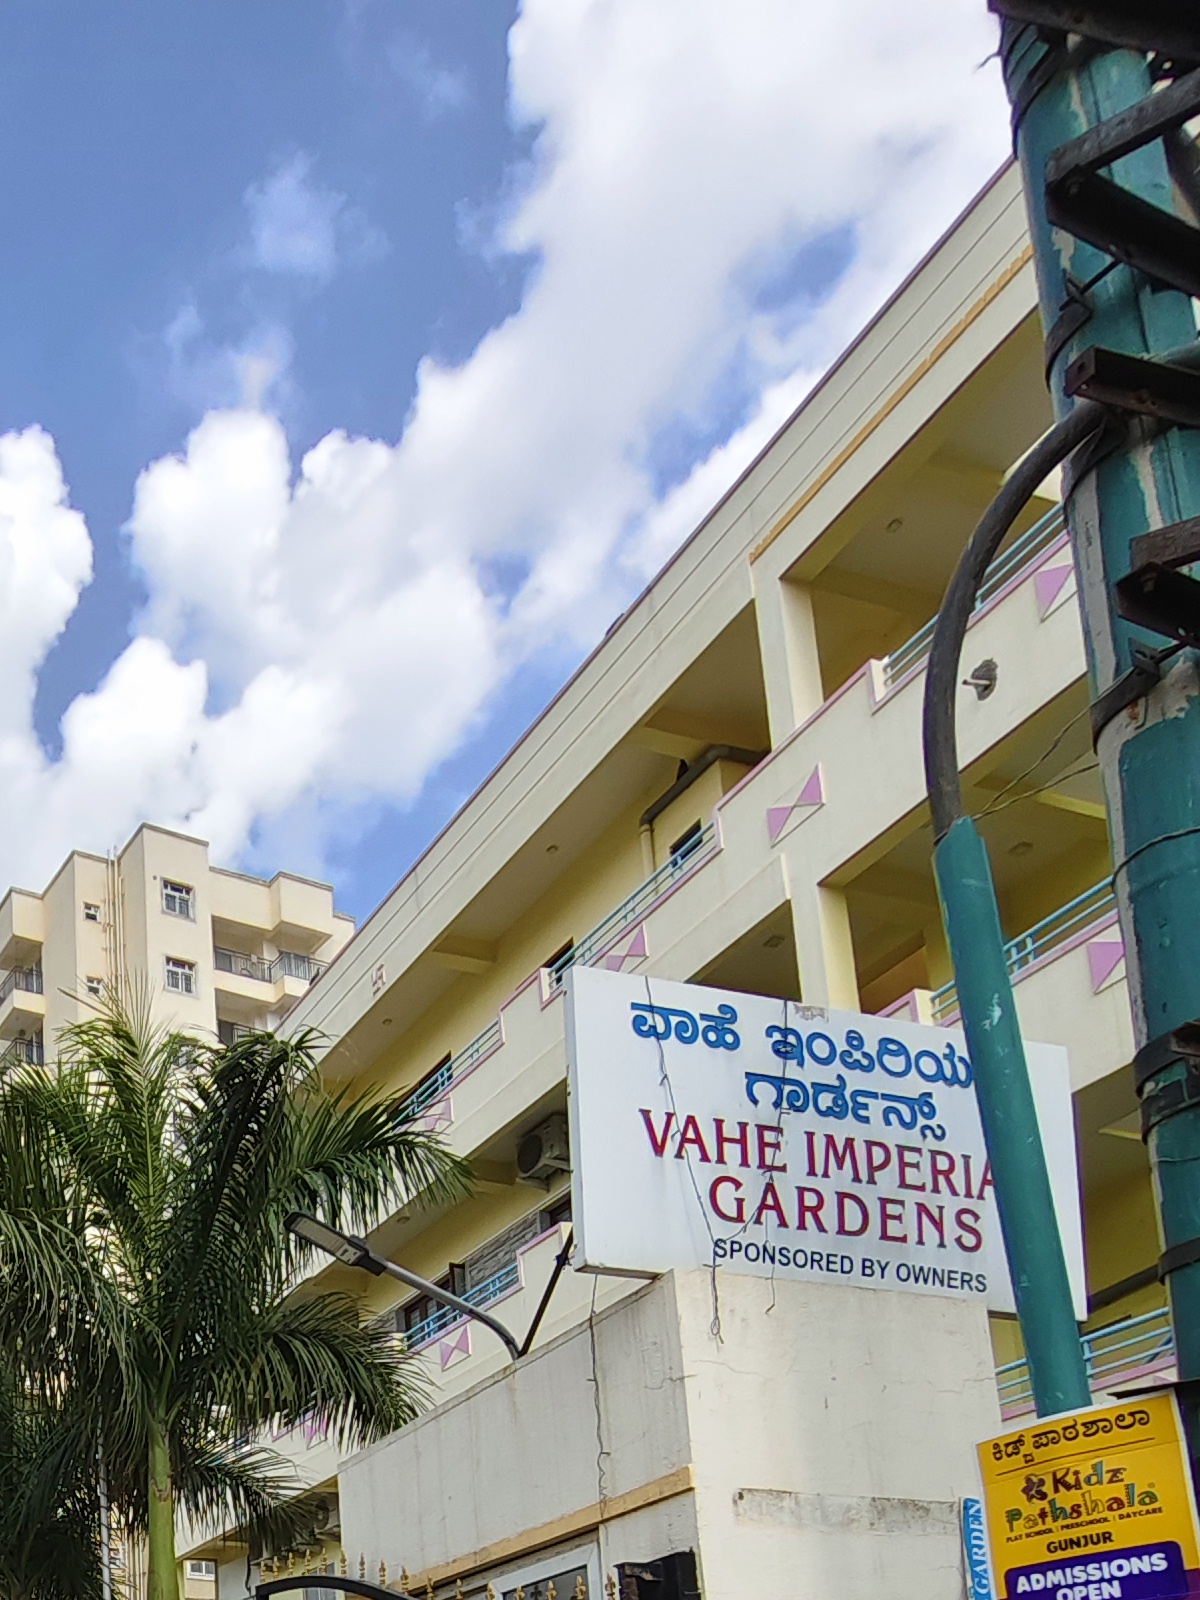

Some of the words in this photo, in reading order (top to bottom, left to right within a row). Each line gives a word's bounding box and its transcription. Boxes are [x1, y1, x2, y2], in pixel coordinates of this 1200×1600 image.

[765, 1024, 974, 1089] ಇಂಪಿರಿಯ
[639, 1107, 789, 1174] VAHE
[805, 1130, 994, 1202] IMPERIA
[709, 1175, 984, 1255] GARDENS
[713, 1238, 855, 1276] SPONSORED
[861, 1257, 891, 1281] BY
[896, 1261, 988, 1295] OWNERS
[1052, 1460, 1128, 1495] Kidz
[1005, 1483, 1159, 1533] Pathshala
[1118, 1506, 1164, 1521] DAYCARE
[1046, 1531, 1115, 1554] GUNJUR
[1016, 1552, 1168, 1594] ADMISSIONS
